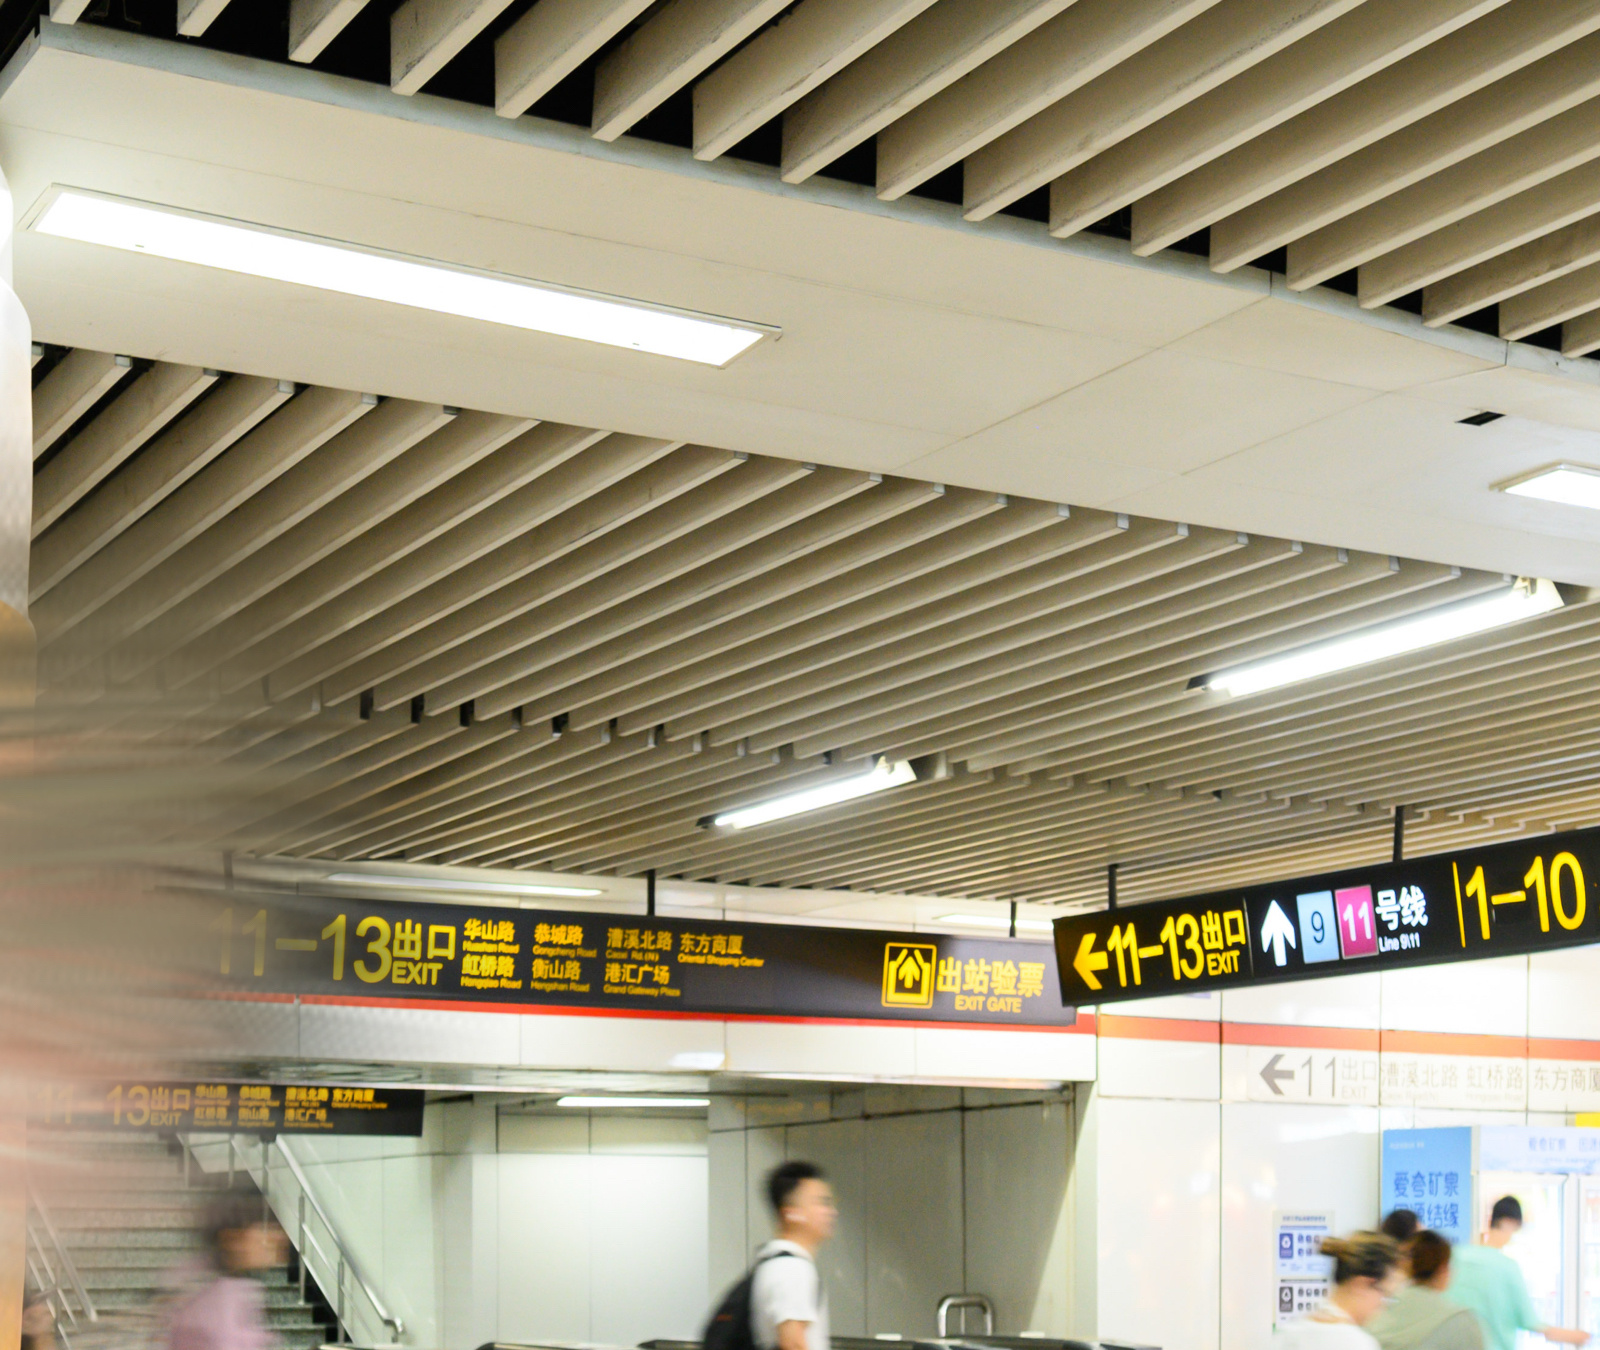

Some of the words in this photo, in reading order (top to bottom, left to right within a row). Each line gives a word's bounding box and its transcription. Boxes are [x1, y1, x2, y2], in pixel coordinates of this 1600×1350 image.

[1311, 910, 1324, 943] 9
[1343, 901, 1373, 942] 11
[1375, 885, 1429, 931] 号线
[393, 919, 456, 960] 出口
[463, 918, 515, 942] 华山路
[679, 932, 743, 955] 东方商厦
[1107, 913, 1204, 987] 11-13
[1201, 909, 1246, 950] 出口
[1378, 936, 1400, 953] Line
[392, 962, 443, 985] EXIT
[604, 962, 670, 985] 港汇广场
[1206, 950, 1241, 976] EXIT
[936, 957, 1046, 998] 出站验票
[954, 995, 986, 1011] EXIT
[986, 997, 1022, 1013] GATE
[1301, 1055, 1336, 1098] 11
[1341, 1059, 1377, 1083] 出口
[1466, 1064, 1525, 1093] 虹桥路
[151, 1086, 191, 1111] 出口
[151, 1111, 182, 1126] EXIT
[1393, 1170, 1460, 1198] 爱夸矿泉
